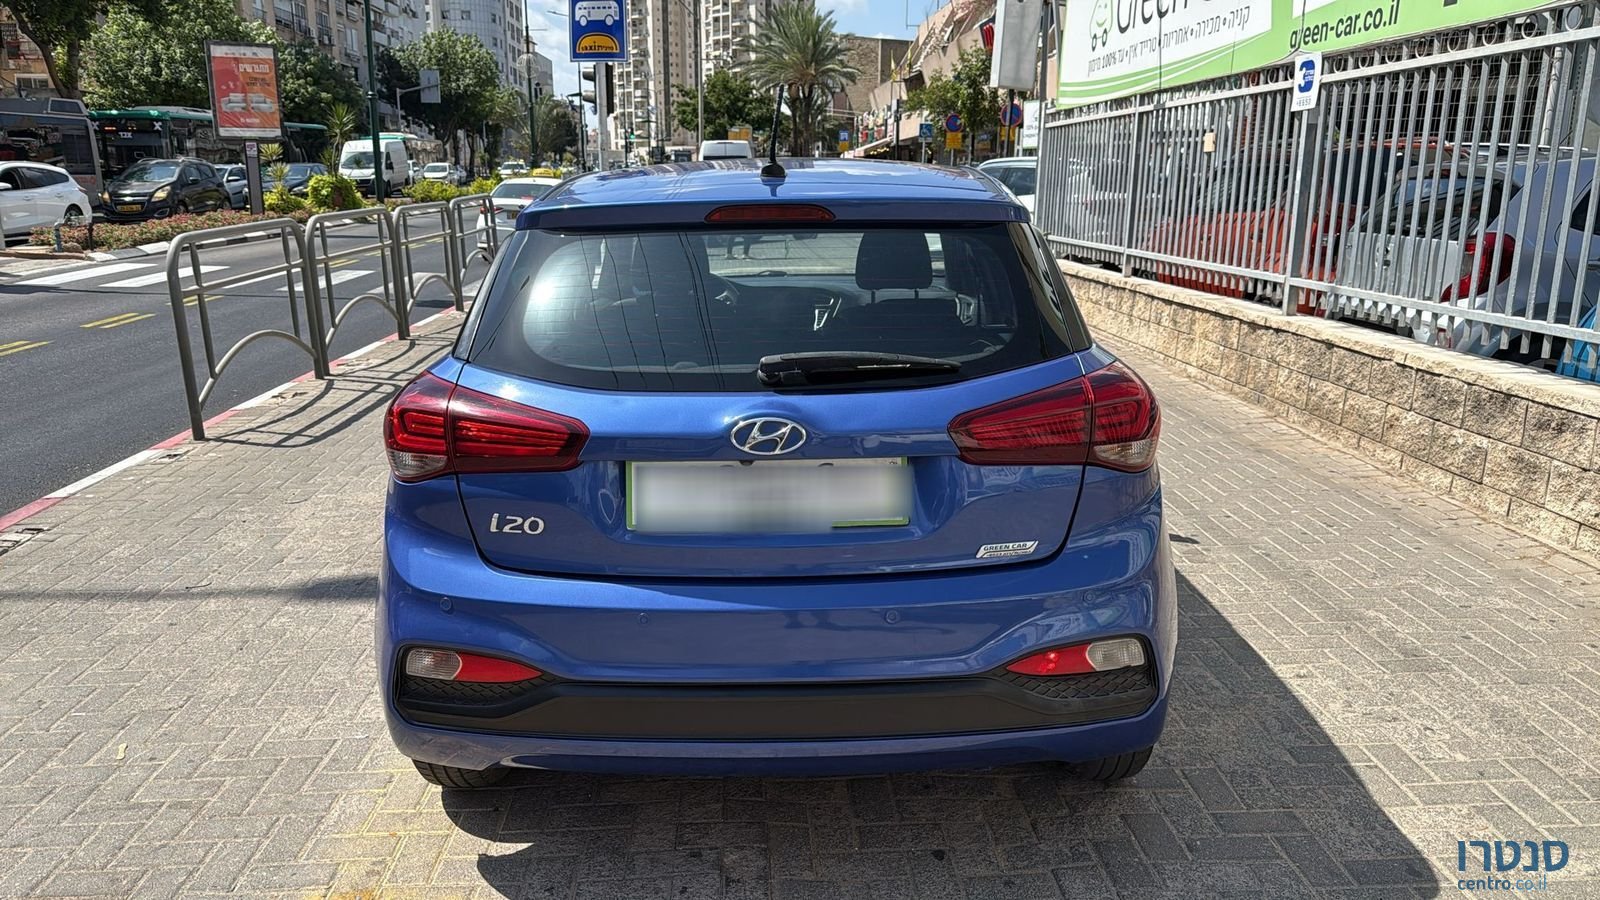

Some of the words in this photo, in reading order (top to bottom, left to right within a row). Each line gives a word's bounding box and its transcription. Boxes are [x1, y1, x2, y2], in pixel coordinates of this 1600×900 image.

[1195, 15, 1220, 39] מכירה
[1228, 6, 1250, 31] קניה
[1290, 0, 1400, 49] green-car.co.il
[1162, 25, 1189, 49] אחריות
[1102, 53, 1117, 68] 100%
[490, 513, 545, 535] i20
